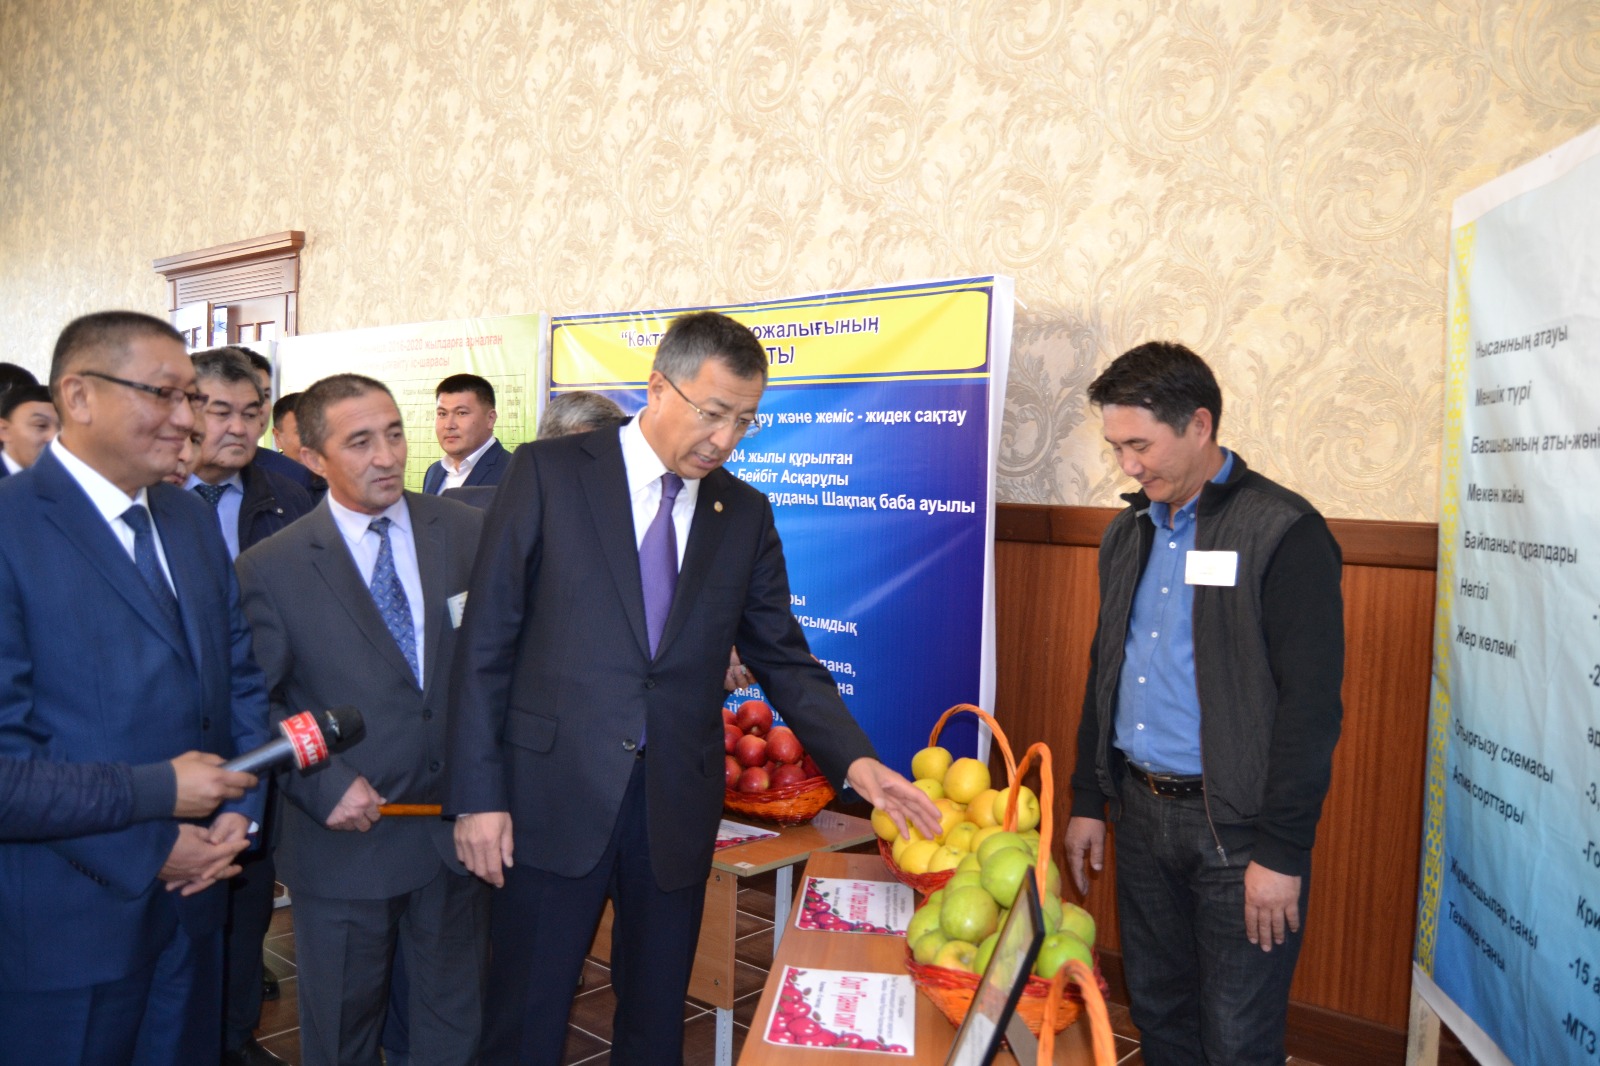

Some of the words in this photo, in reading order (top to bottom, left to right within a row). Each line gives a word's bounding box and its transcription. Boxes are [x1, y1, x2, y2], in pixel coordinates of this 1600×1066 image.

[1533, 325, 1568, 349] атауы
[765, 346, 795, 365] ТЫ
[1507, 379, 1533, 406] түрі
[777, 412, 813, 424] және
[815, 408, 855, 424] жеміс
[865, 410, 912, 426] жидек
[914, 409, 968, 427] сақтау
[747, 452, 787, 464] жылы
[789, 452, 854, 468] құрылған
[737, 468, 779, 484] Бейбіт
[780, 469, 849, 489] Асқарұлы
[767, 491, 819, 507] ауданы
[821, 490, 877, 511] Шақпақ
[879, 493, 916, 511] баба
[919, 498, 976, 516] ауылы
[1466, 483, 1500, 502] Мекен
[1500, 484, 1525, 504] жайы
[1463, 531, 1517, 555] Байланыс
[1518, 541, 1578, 568] құралдары
[1459, 578, 1490, 601] Негізі
[1455, 624, 1477, 651] Жер
[1478, 634, 1517, 659] көлемі
[1501, 746, 1554, 784] схемасы
[1472, 783, 1525, 825] сорттары
[1509, 915, 1539, 950] саны
[1568, 956, 1591, 986] -15
